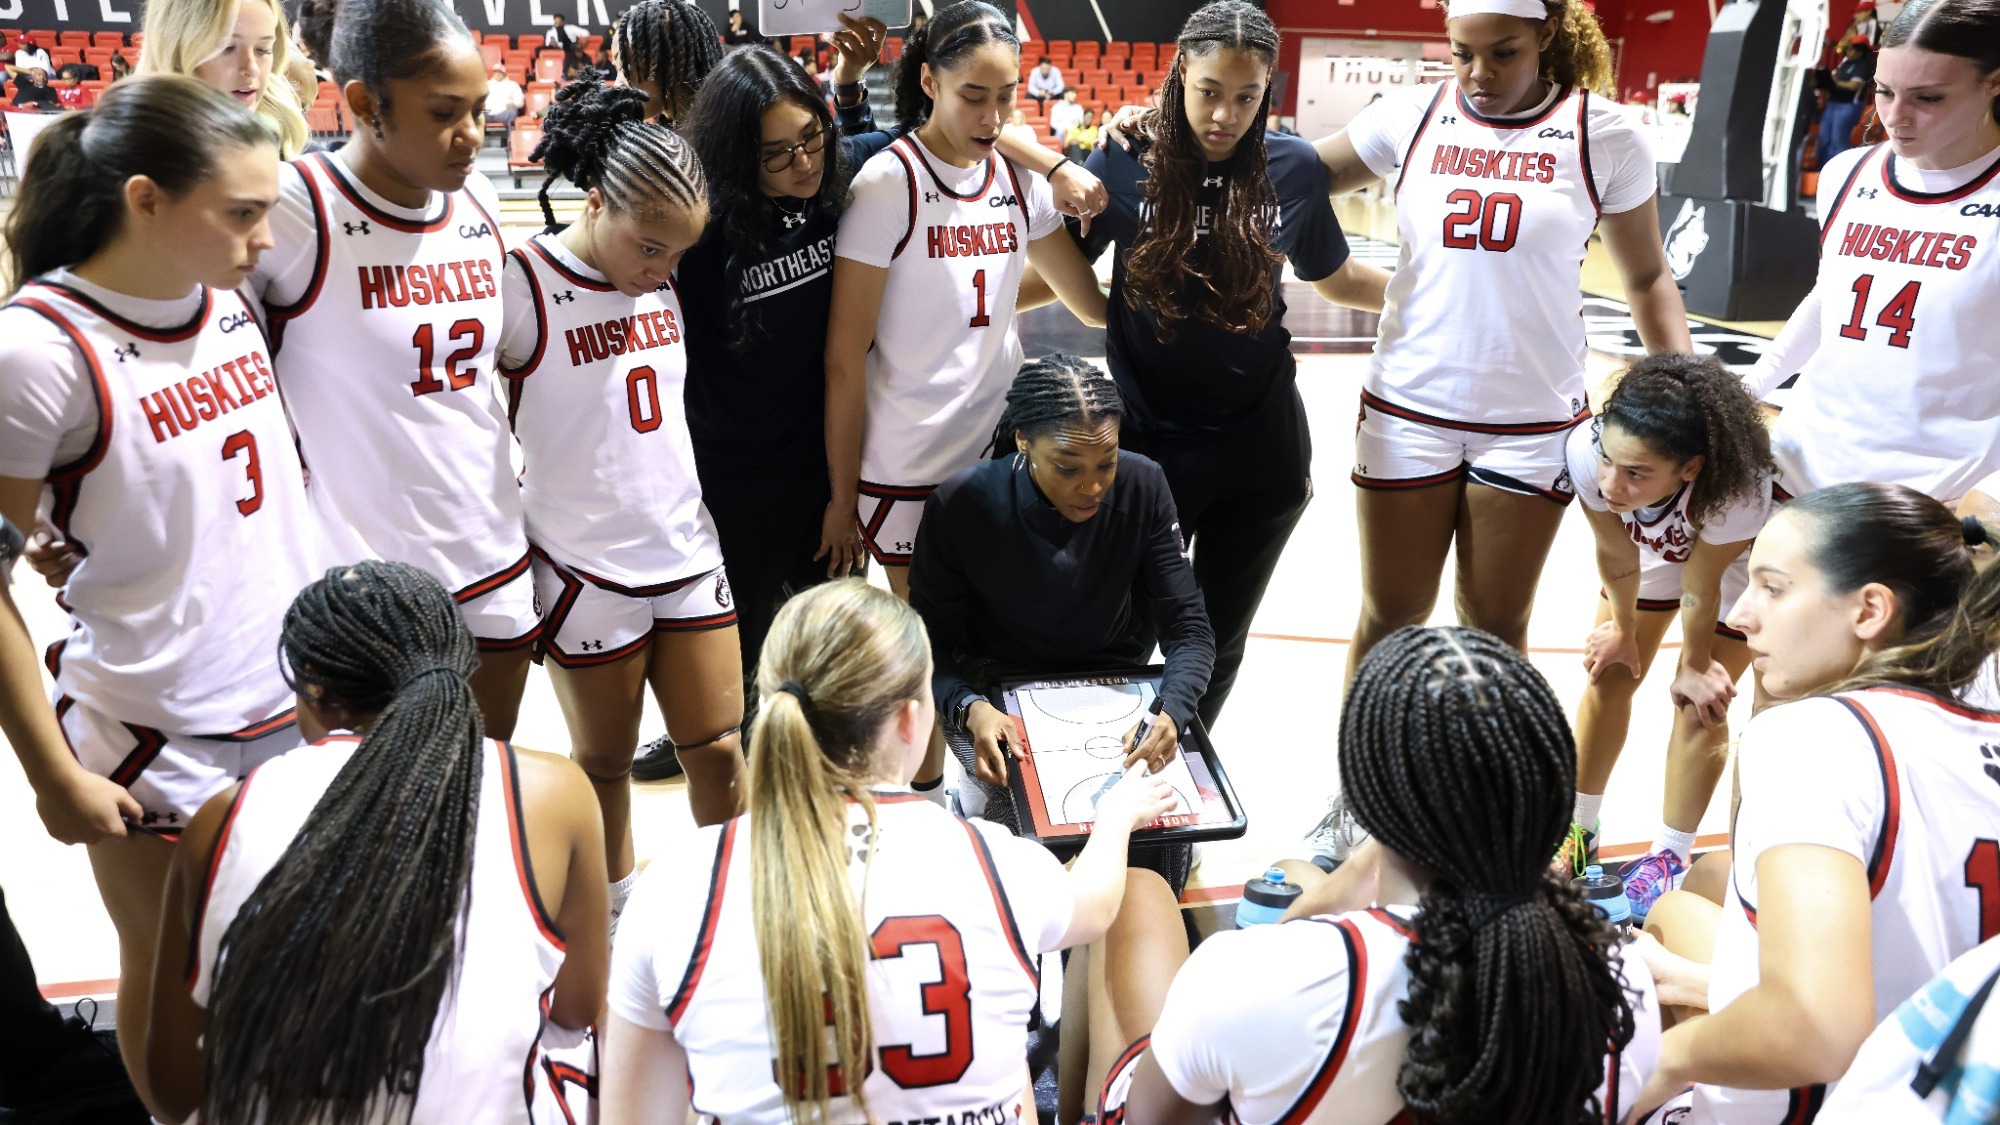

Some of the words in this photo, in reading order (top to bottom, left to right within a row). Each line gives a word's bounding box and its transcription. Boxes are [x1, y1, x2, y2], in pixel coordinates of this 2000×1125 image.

[1538, 128, 1575, 140] CAA
[1430, 144, 1557, 184] HUSKIES
[989, 195, 1018, 208] CAA
[1443, 188, 1523, 252] 20
[459, 223, 492, 239] CAA
[928, 222, 1018, 258] HUSKIES
[1838, 222, 1977, 271] HUSKIES
[358, 259, 496, 309] HUSKIES
[969, 269, 990, 328] 1
[219, 311, 253, 333] CAA
[1839, 273, 1922, 349] 14
[411, 318, 484, 397] 12
[565, 309, 680, 366] HUSKIES
[139, 351, 275, 443] HUSKIES
[626, 365, 662, 434] 0
[222, 429, 264, 517] 3
[1035, 677, 1129, 689] NORTHEASTERN
